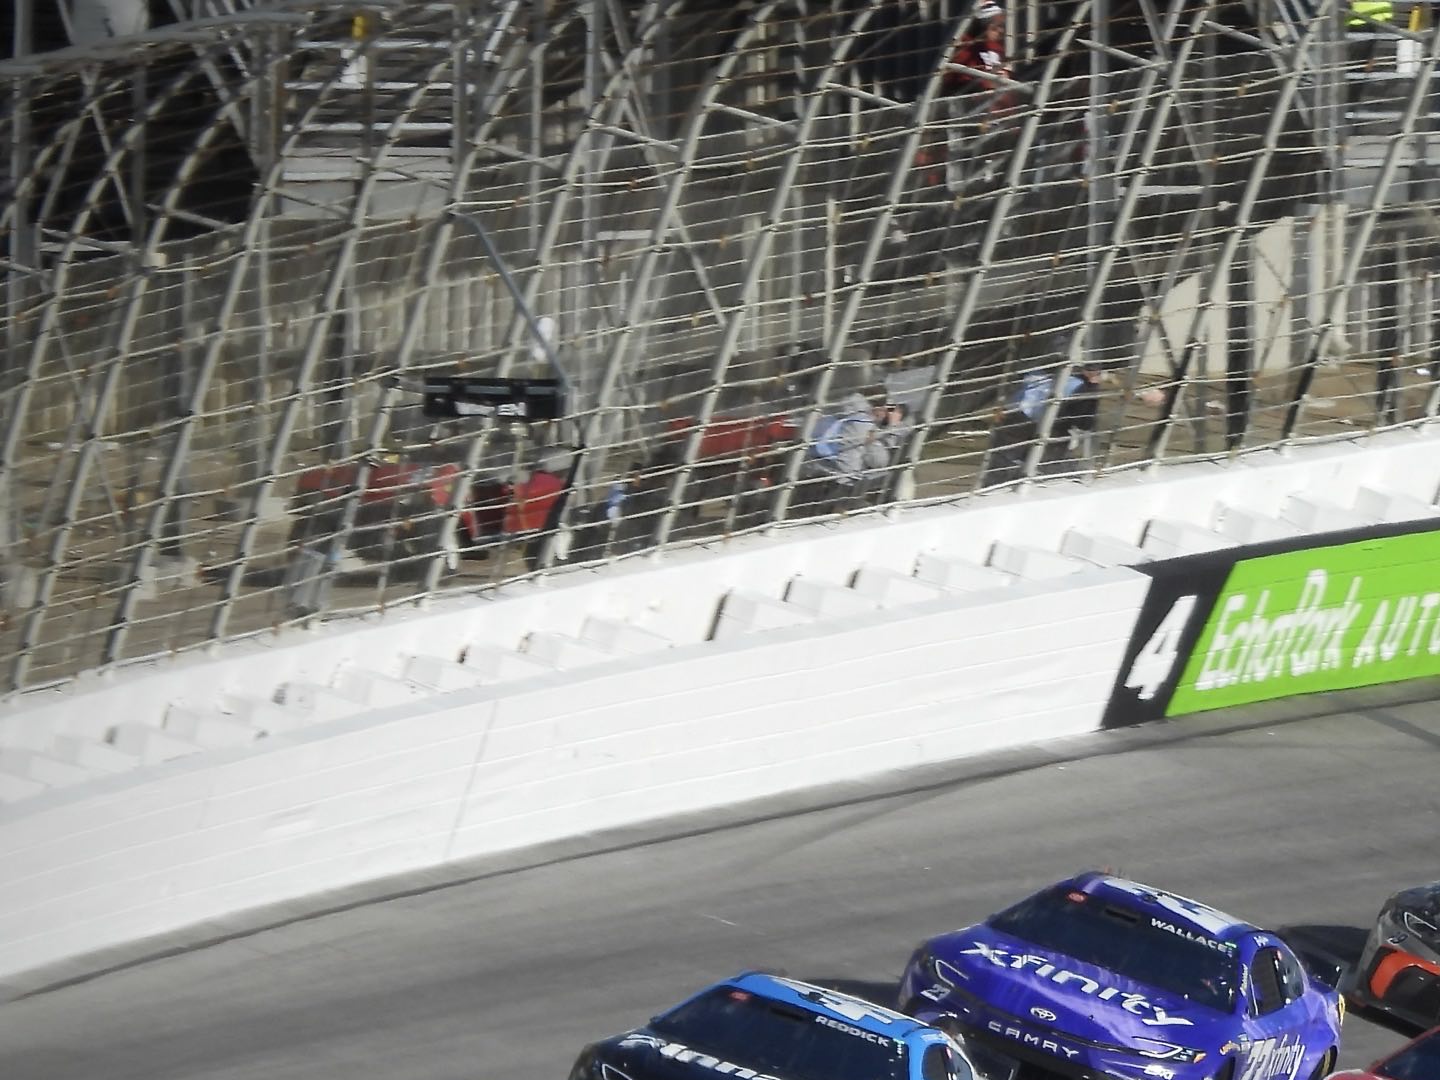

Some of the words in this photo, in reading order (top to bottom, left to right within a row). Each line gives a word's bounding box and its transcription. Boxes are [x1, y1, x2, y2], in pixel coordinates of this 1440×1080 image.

[1125, 595, 1199, 700] 4
[1193, 569, 1361, 691] EchoPark
[1151, 917, 1228, 953] WALLACE
[815, 1016, 889, 1048] REDDICK
[988, 1020, 1079, 1058] CAMRY
